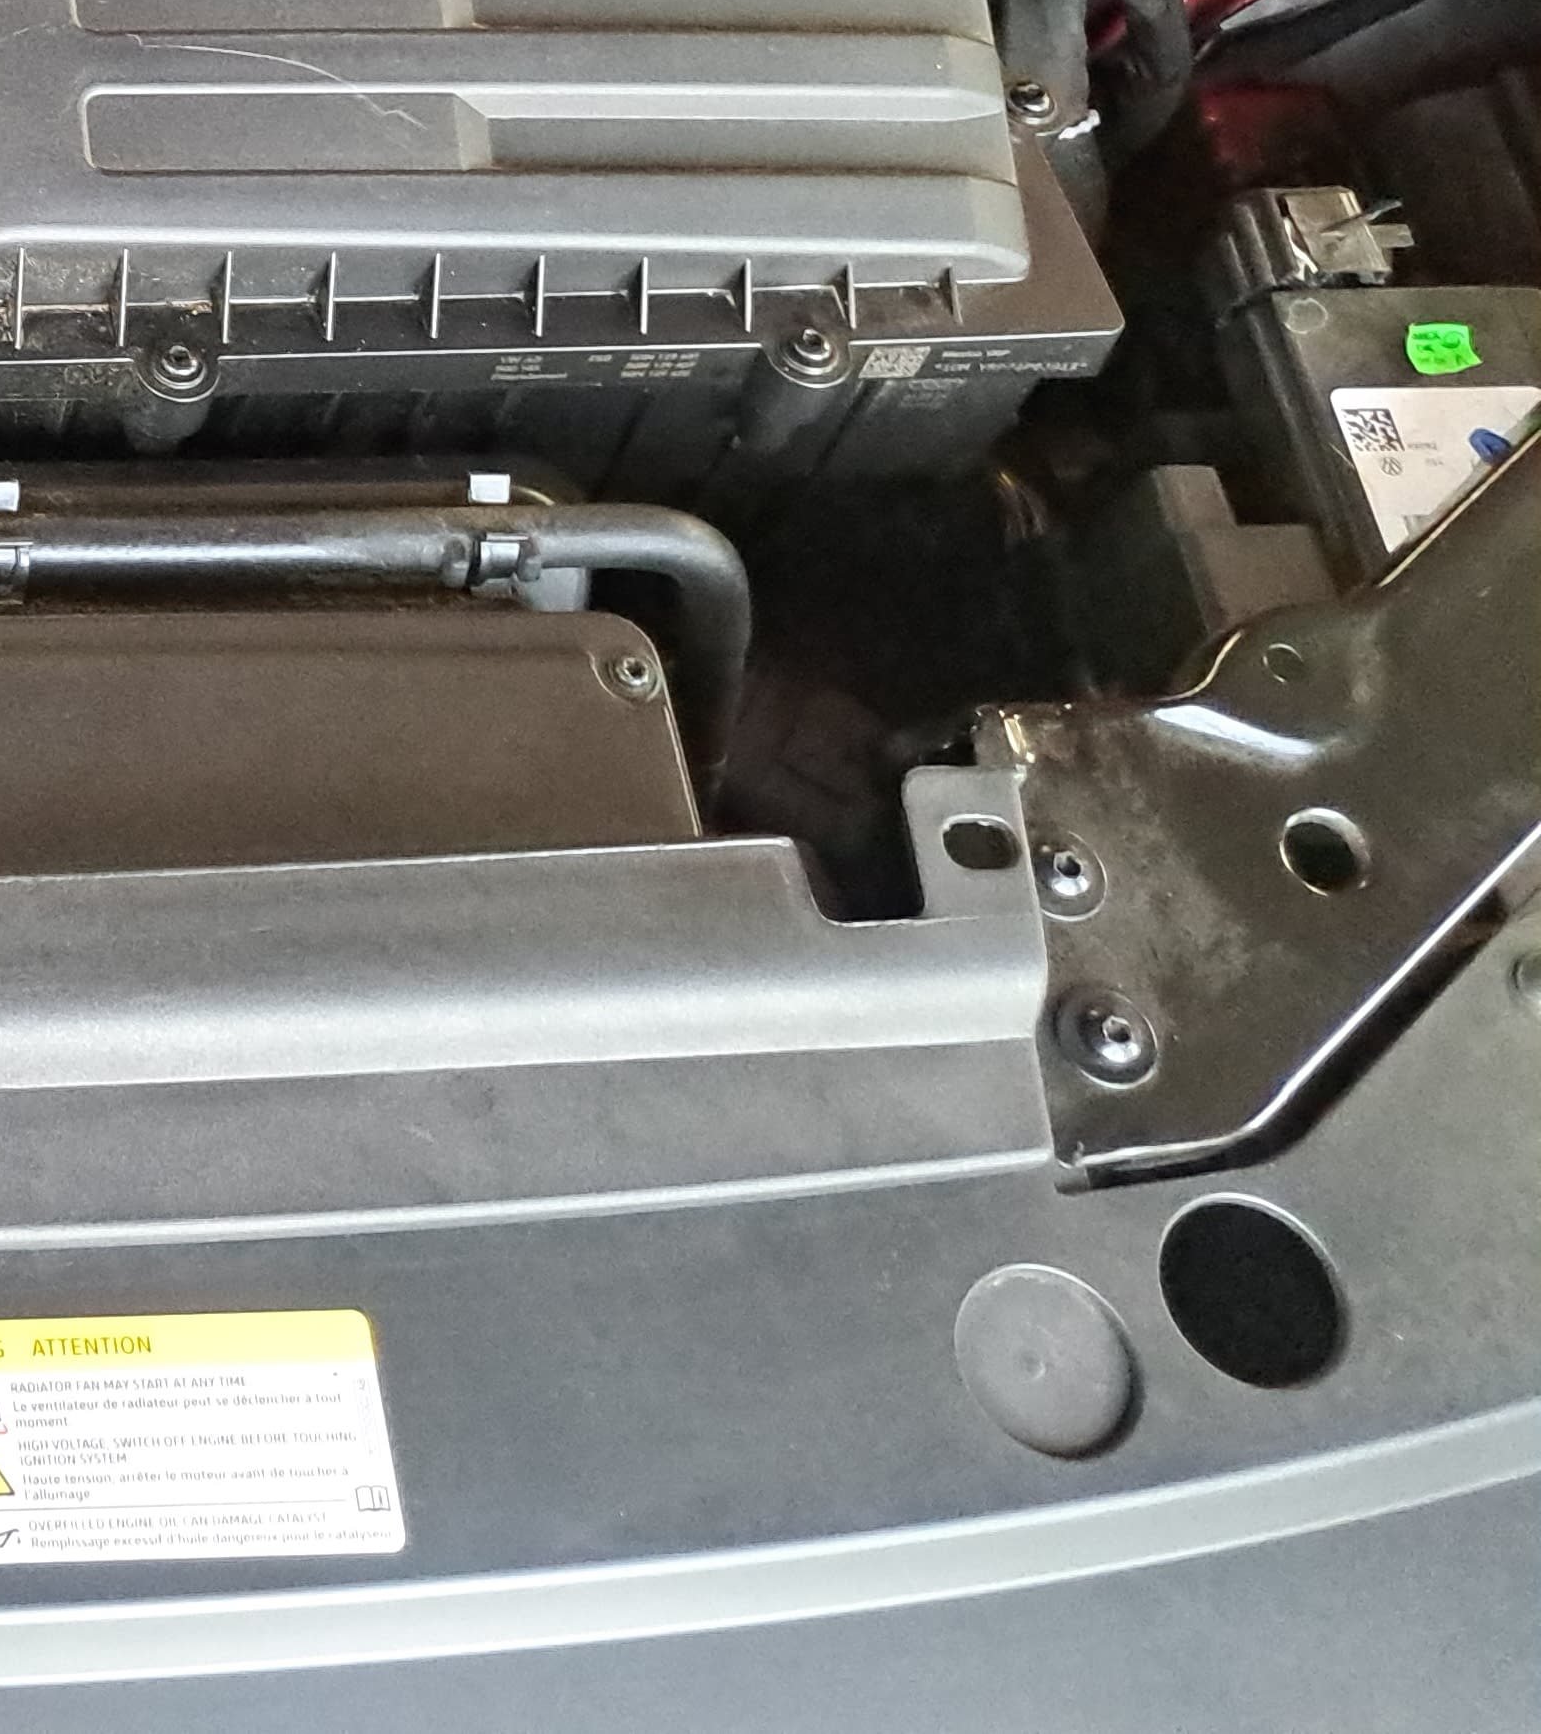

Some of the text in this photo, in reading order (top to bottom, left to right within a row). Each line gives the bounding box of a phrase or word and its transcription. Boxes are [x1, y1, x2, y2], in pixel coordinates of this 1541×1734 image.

[32, 1335, 152, 1357] ATTENTION
[11, 1381, 71, 1393] RADIATOR
[104, 1379, 129, 1390] MAY
[133, 1378, 169, 1389] START
[191, 1377, 215, 1388] ANY
[13, 1400, 27, 1412] Le
[31, 1400, 99, 1412] ventilateur
[103, 1399, 118, 1409] de
[123, 1397, 179, 1409] radiateur
[183, 1396, 211, 1409] peut
[316, 1393, 342, 1403] tout
[18, 1440, 49, 1451] HIGH
[20, 1453, 76, 1466] IGNITION
[23, 1474, 61, 1485] Haute
[180, 1469, 226, 1481] moteur
